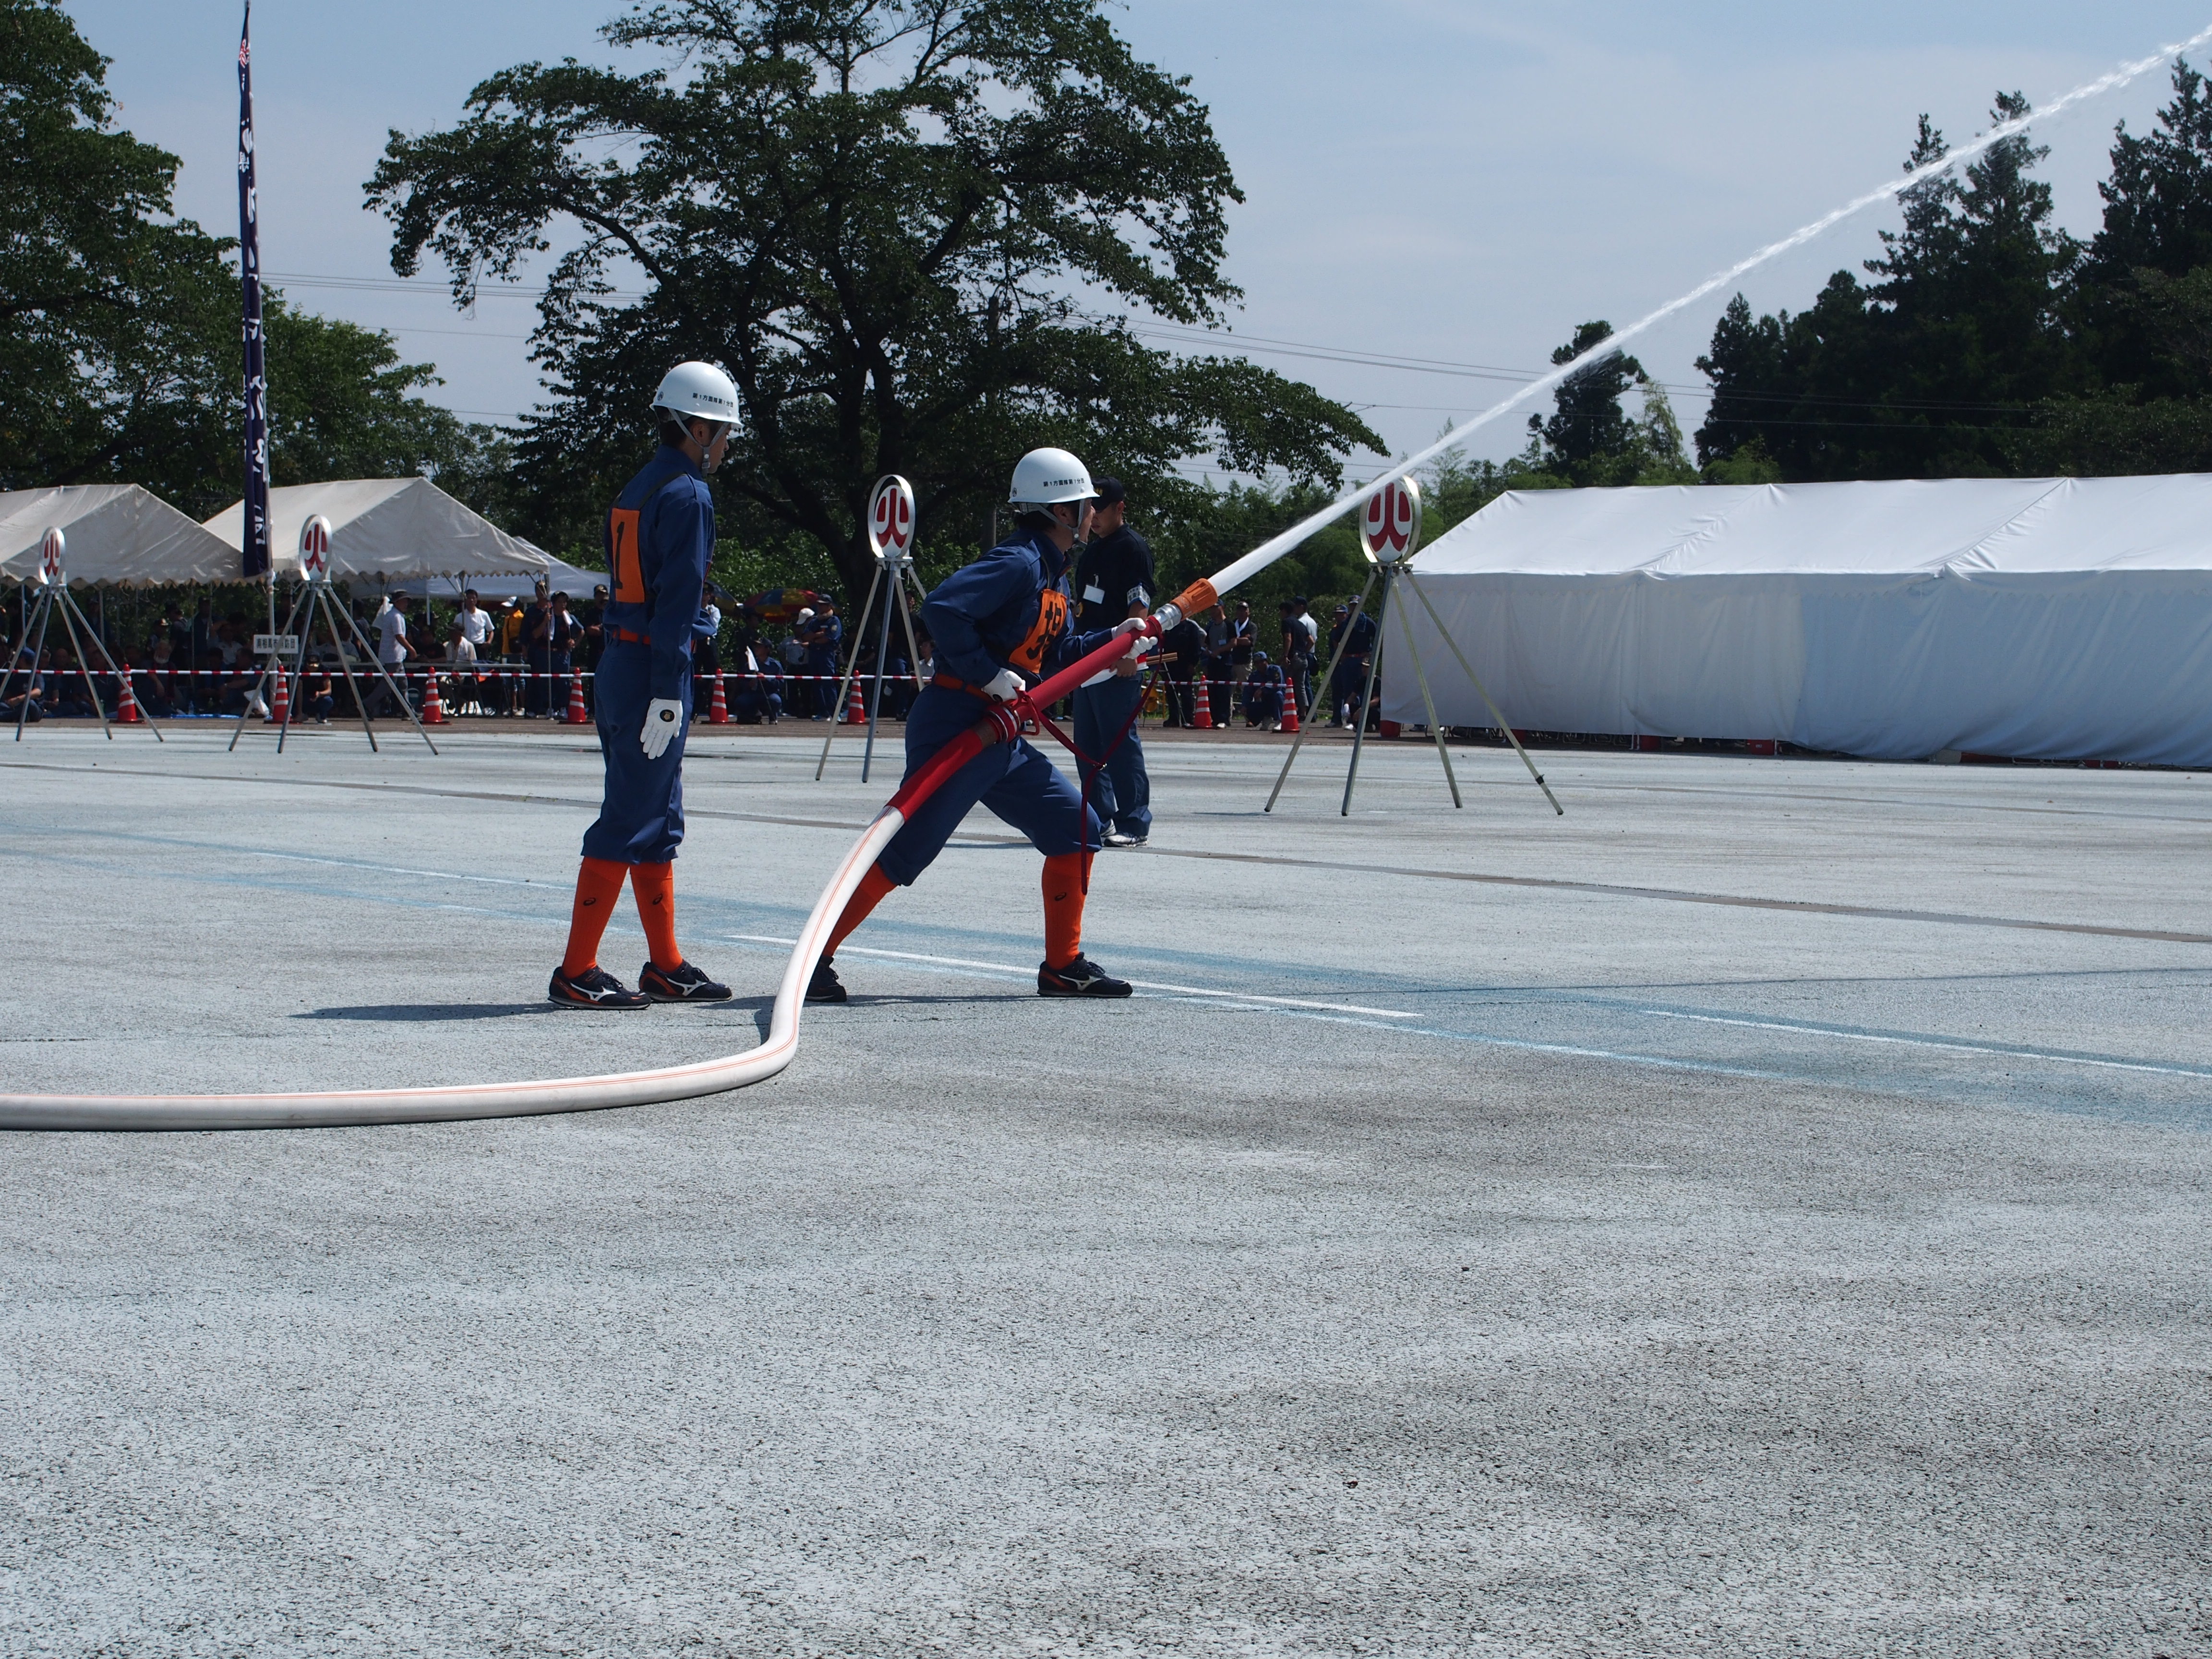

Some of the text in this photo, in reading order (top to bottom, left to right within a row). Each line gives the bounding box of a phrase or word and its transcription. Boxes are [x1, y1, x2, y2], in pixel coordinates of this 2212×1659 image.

[615, 521, 625, 589] 1
[256, 638, 295, 649] 南相馬市防団
